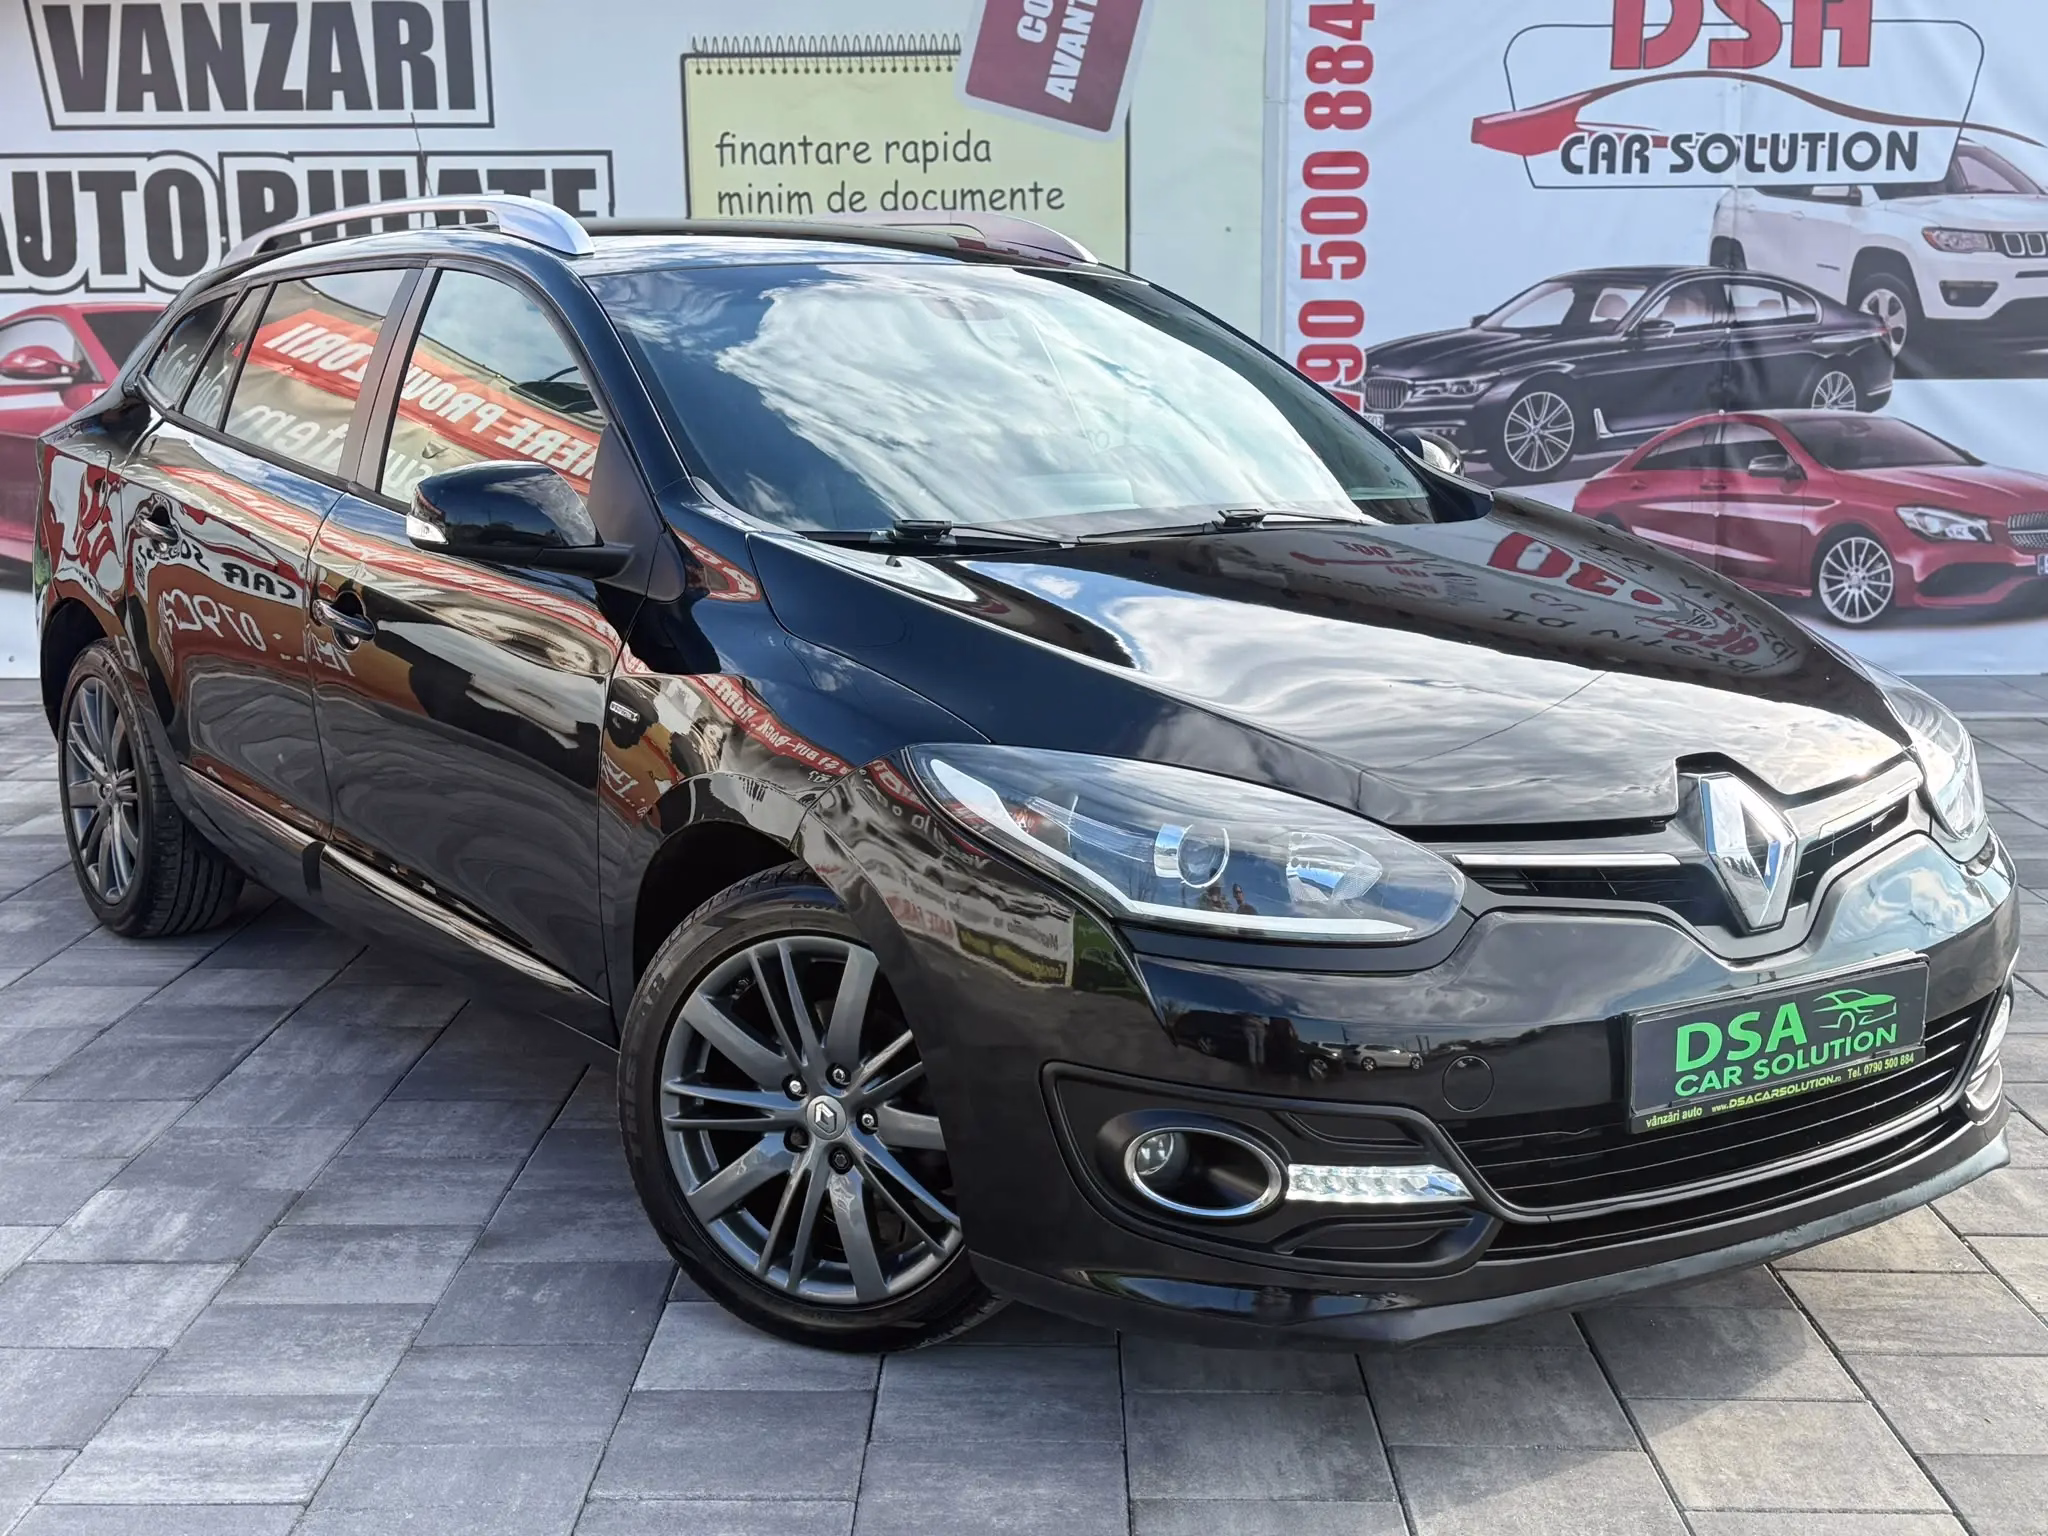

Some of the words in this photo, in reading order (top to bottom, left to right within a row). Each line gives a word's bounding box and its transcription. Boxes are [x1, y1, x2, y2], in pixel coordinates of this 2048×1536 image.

[42, 0, 477, 112] VANZARI
[1304, 0, 1375, 130] 884
[715, 131, 872, 168] finantare
[885, 129, 992, 174] rapida
[1560, 132, 1652, 175] CAR
[1669, 130, 1919, 174] SOLUTION
[717, 183, 815, 216] minim
[826, 180, 868, 213] de
[880, 179, 1066, 212] documente
[1300, 150, 1369, 280] 500
[1674, 1065, 1743, 1097] CAR
[1752, 1023, 1897, 1081] SOLUTION
[1675, 1001, 1808, 1073] DSA
[1645, 1109, 1681, 1129] vânzări
[1682, 1105, 1703, 1120] auto
[1711, 1074, 1842, 1113] www.DSACARSOLUTION.ro
[1847, 1067, 1862, 1080] Tel.
[1863, 1060, 1883, 1076] 0790
[1884, 1056, 1898, 1070] 500
[1899, 1052, 1915, 1067] 884
